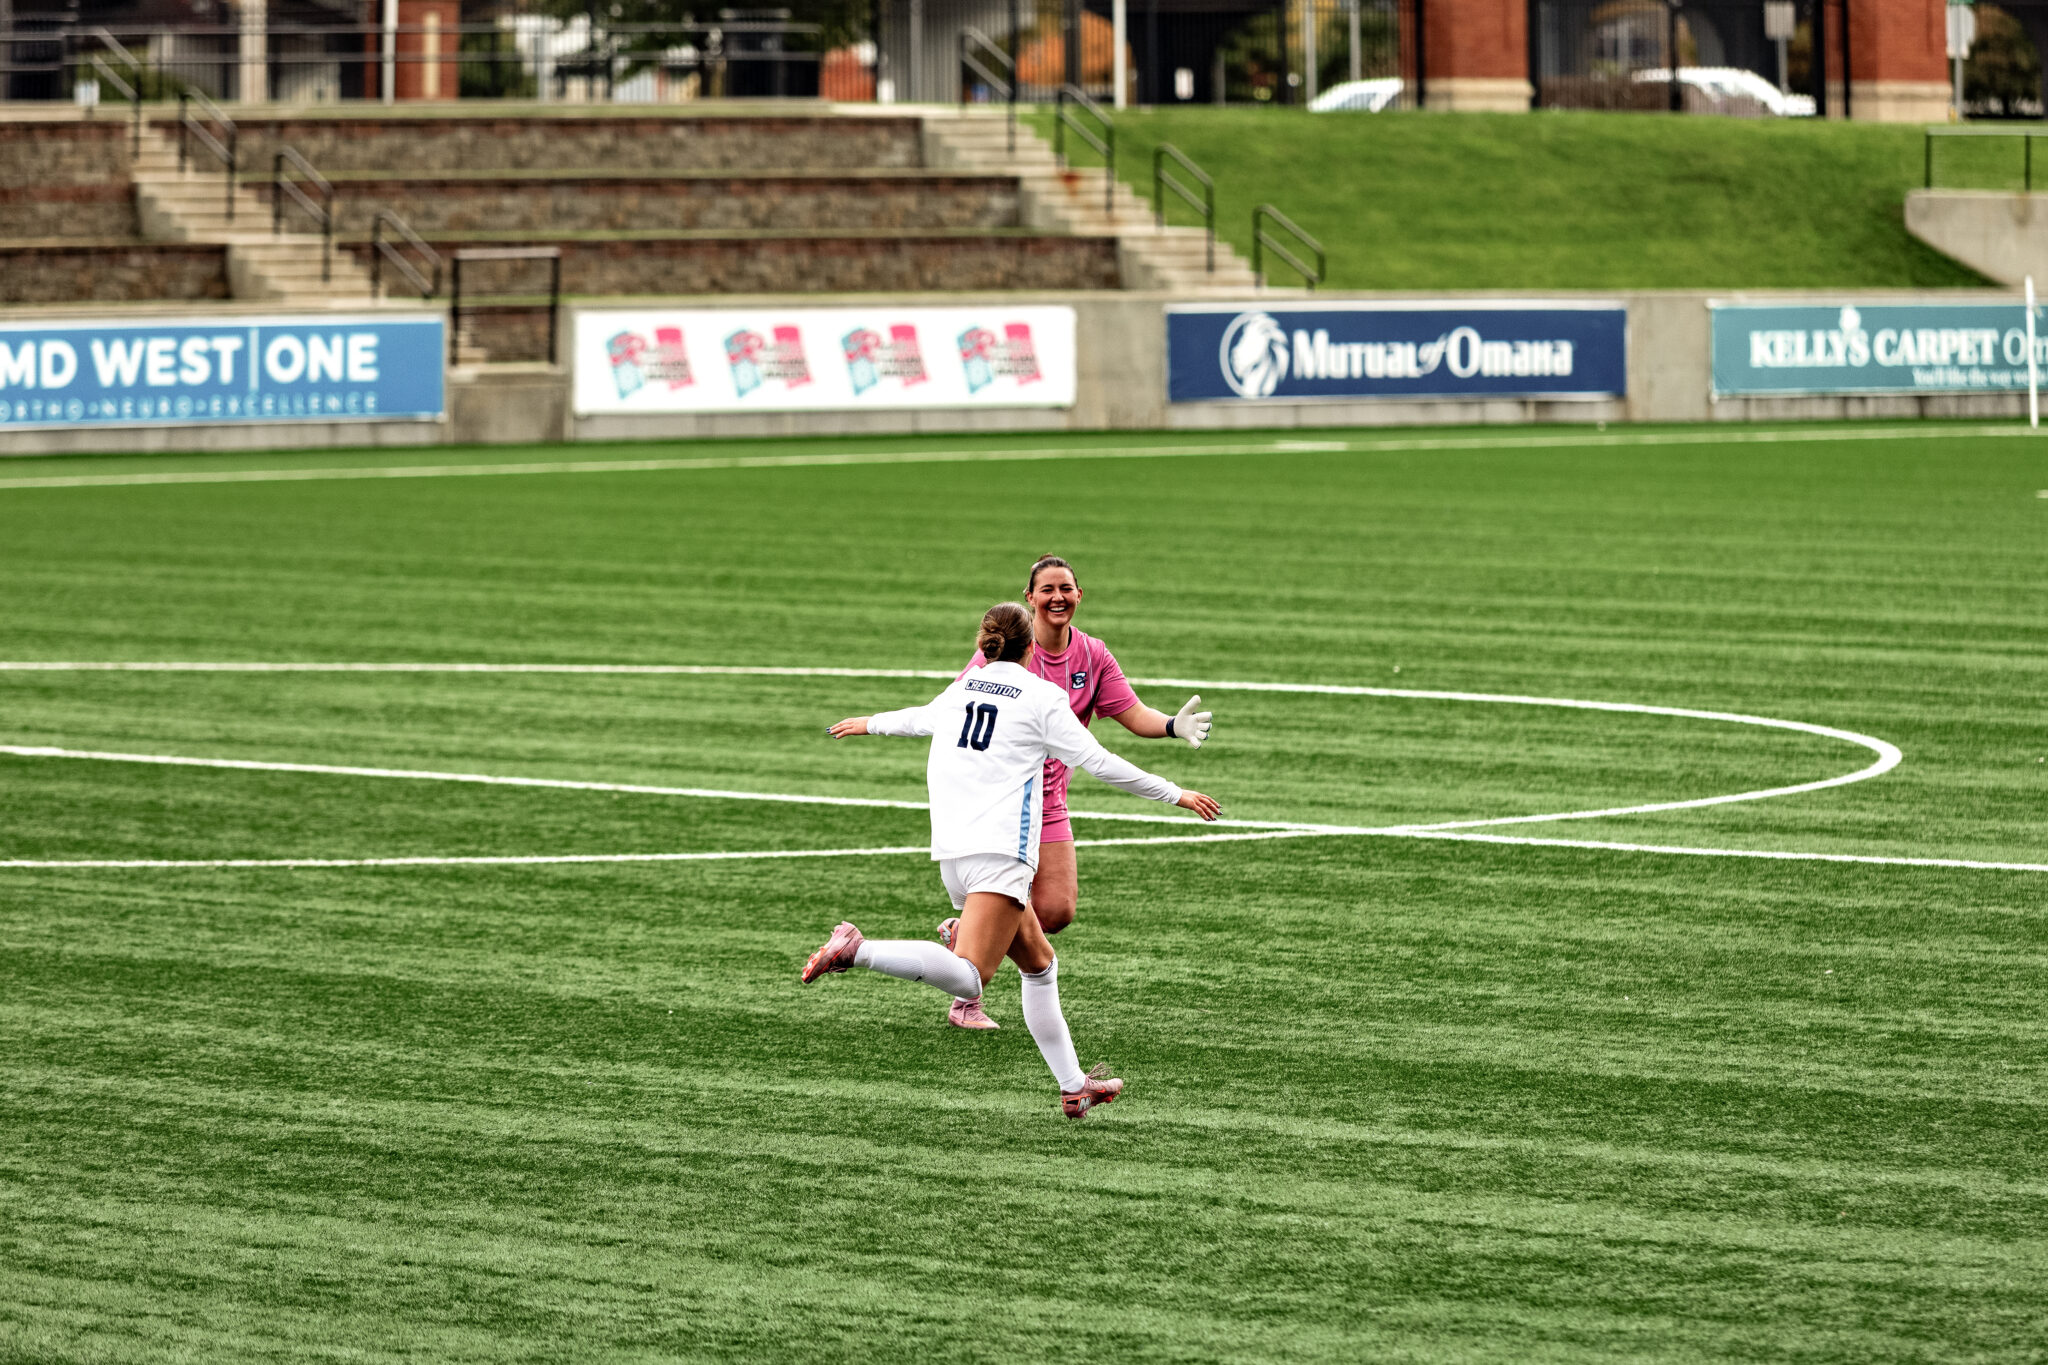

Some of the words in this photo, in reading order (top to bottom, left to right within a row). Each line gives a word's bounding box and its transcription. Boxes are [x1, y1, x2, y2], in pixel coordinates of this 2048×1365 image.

[0, 339, 78, 390] MD
[90, 335, 244, 389] WEST
[265, 332, 380, 385] ONE
[1873, 327, 1999, 367] CARPET
[965, 678, 1022, 699] CREIGHTON
[957, 701, 998, 752] 10
